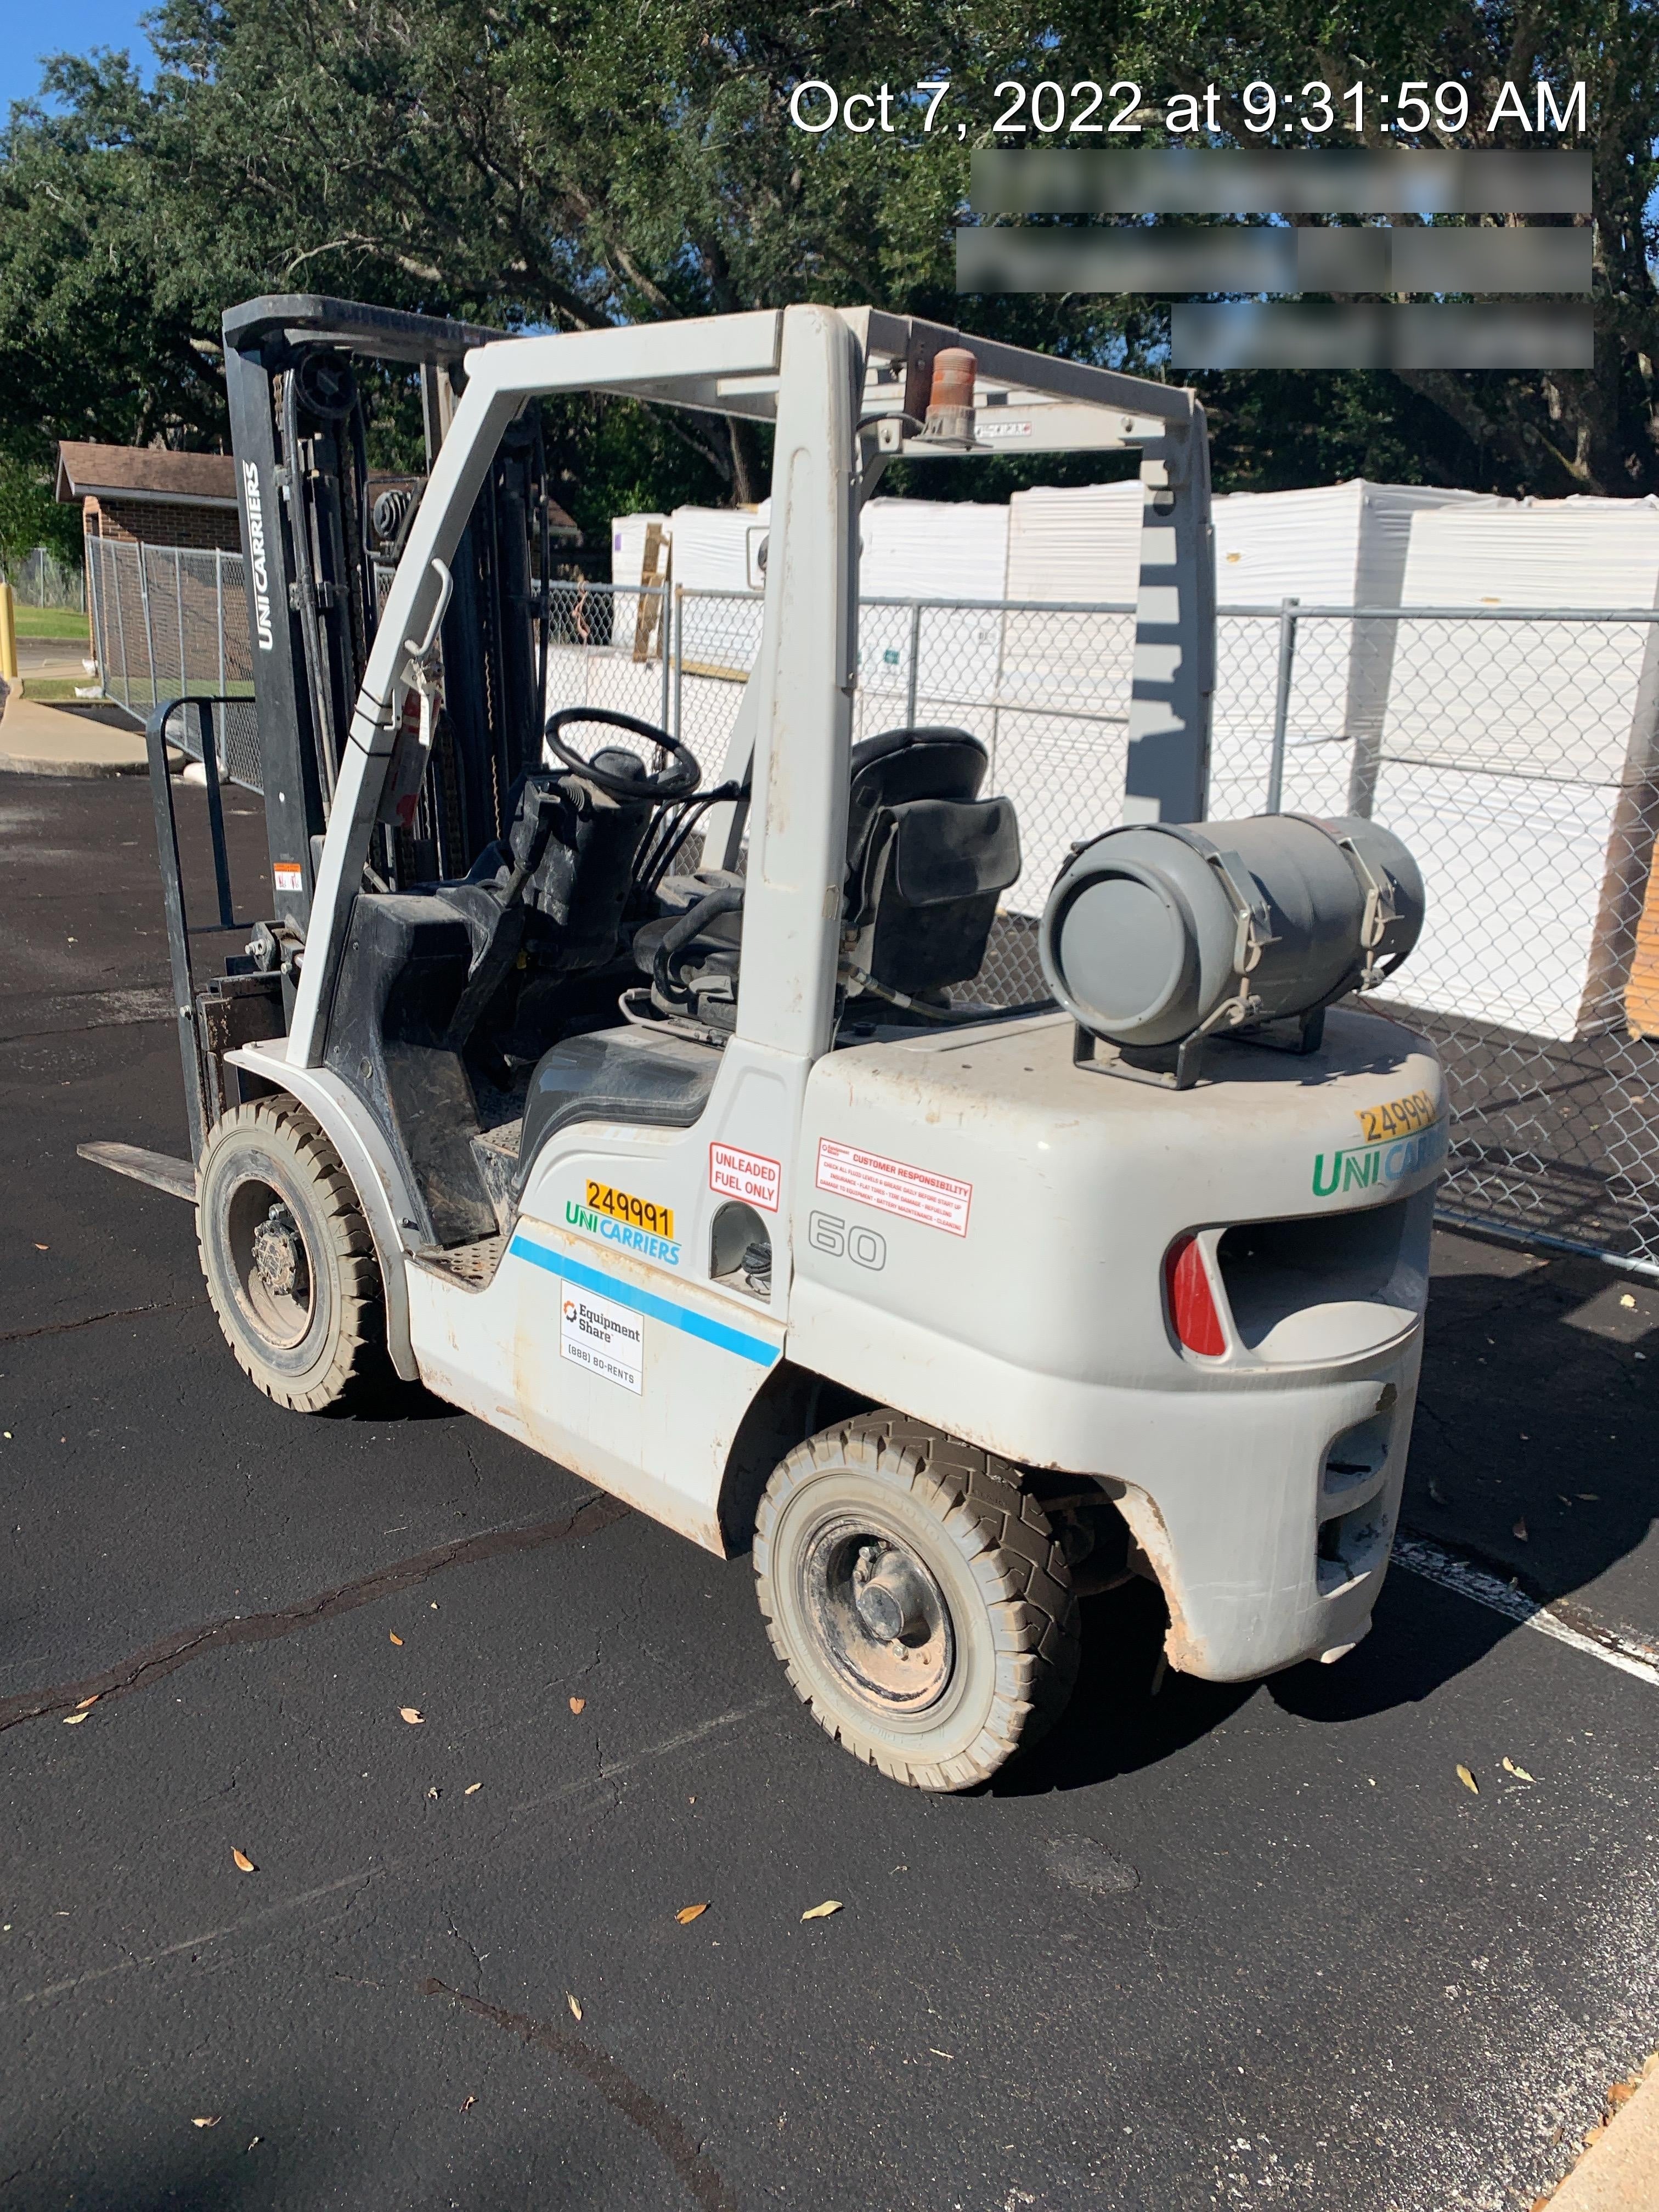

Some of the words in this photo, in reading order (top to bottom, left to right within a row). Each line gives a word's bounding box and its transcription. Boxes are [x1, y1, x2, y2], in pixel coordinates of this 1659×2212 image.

[242, 460, 273, 651] UNICARRIERS
[715, 1151, 776, 1182] UNLEADED
[715, 1170, 742, 1192] FUEL
[745, 1181, 775, 1201] ONLY
[823, 1160, 838, 1170] CHECK
[848, 1169, 861, 1178] FLUID
[862, 1173, 878, 1183] LEVELS
[883, 1180, 902, 1191] GREASE
[902, 1187, 917, 1196] DAILY
[918, 1192, 937, 1203] BEFORE
[937, 1198, 953, 1208] START
[830, 1172, 856, 1186] INSURANCE
[860, 1182, 870, 1190] FLAT
[871, 1186, 885, 1195] TIRES
[888, 1192, 899, 1200] TIRE
[853, 1153, 896, 1174] CUSTOMER
[898, 1167, 968, 1197] RESPONSIBILITY
[588, 1181, 669, 1237] 249991
[820, 1178, 838, 1189] DAMAGE
[847, 1187, 873, 1201] EQUIPMENT
[876, 1197, 896, 1209] BATTERY
[898, 1204, 933, 1221] MAINTENANCE
[566, 1200, 681, 1266] UNICARRIERS
[809, 1209, 887, 1272] 60
[579, 1303, 641, 1342] Equipment
[579, 1318, 611, 1343] Share
[568, 1344, 591, 1363] (888)
[593, 1357, 635, 1384] 80-RENTS
